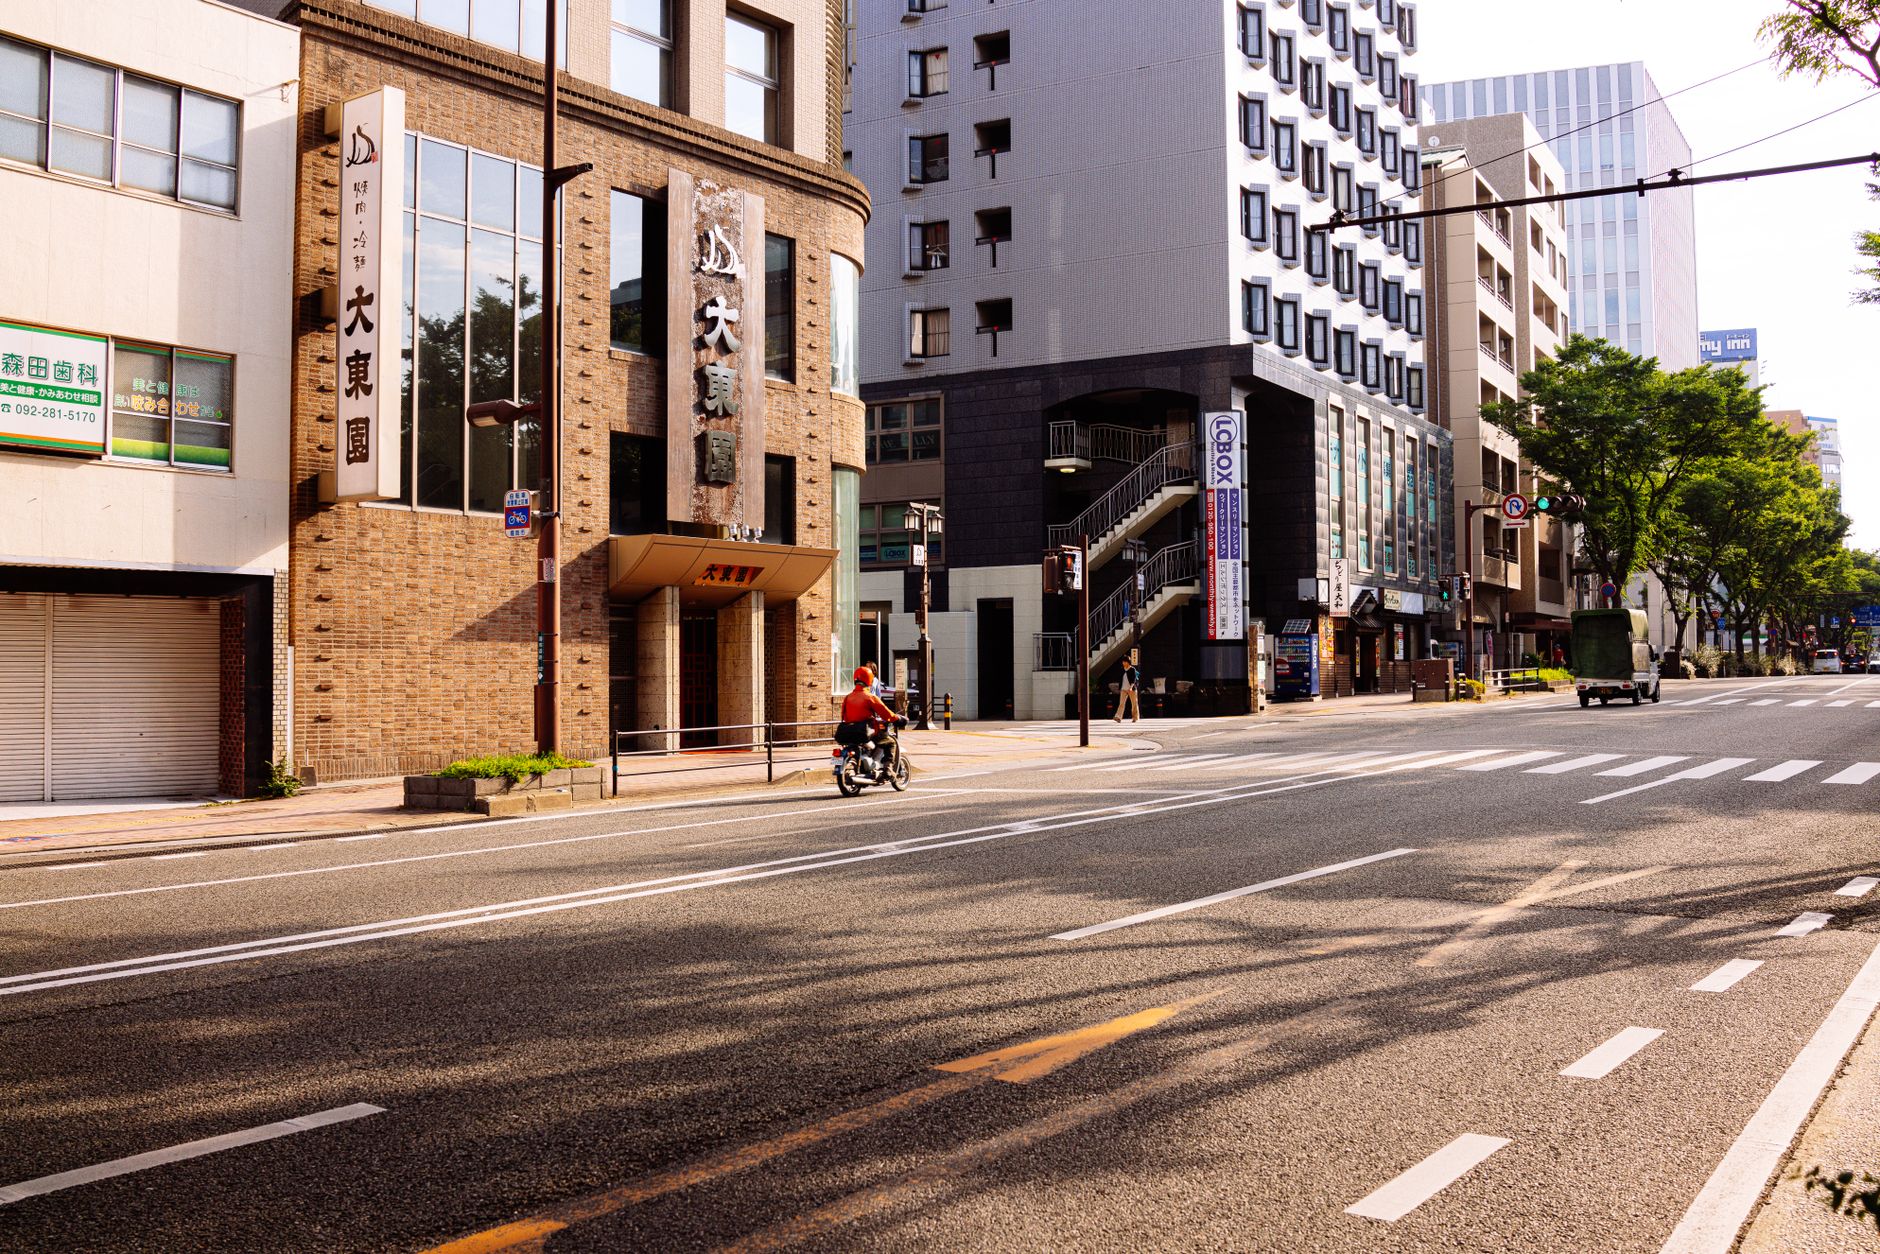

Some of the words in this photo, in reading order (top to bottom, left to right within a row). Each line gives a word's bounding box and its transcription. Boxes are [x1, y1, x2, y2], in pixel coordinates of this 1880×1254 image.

[1727, 338, 1750, 350] inn
[1, 352, 99, 387] 森田歯科
[345, 285, 374, 466] 大東園
[704, 295, 740, 485] 大東園
[15, 404, 96, 423] 092-281-5170
[1216, 420, 1232, 484] LCBOX
[702, 563, 749, 582] 大東園
